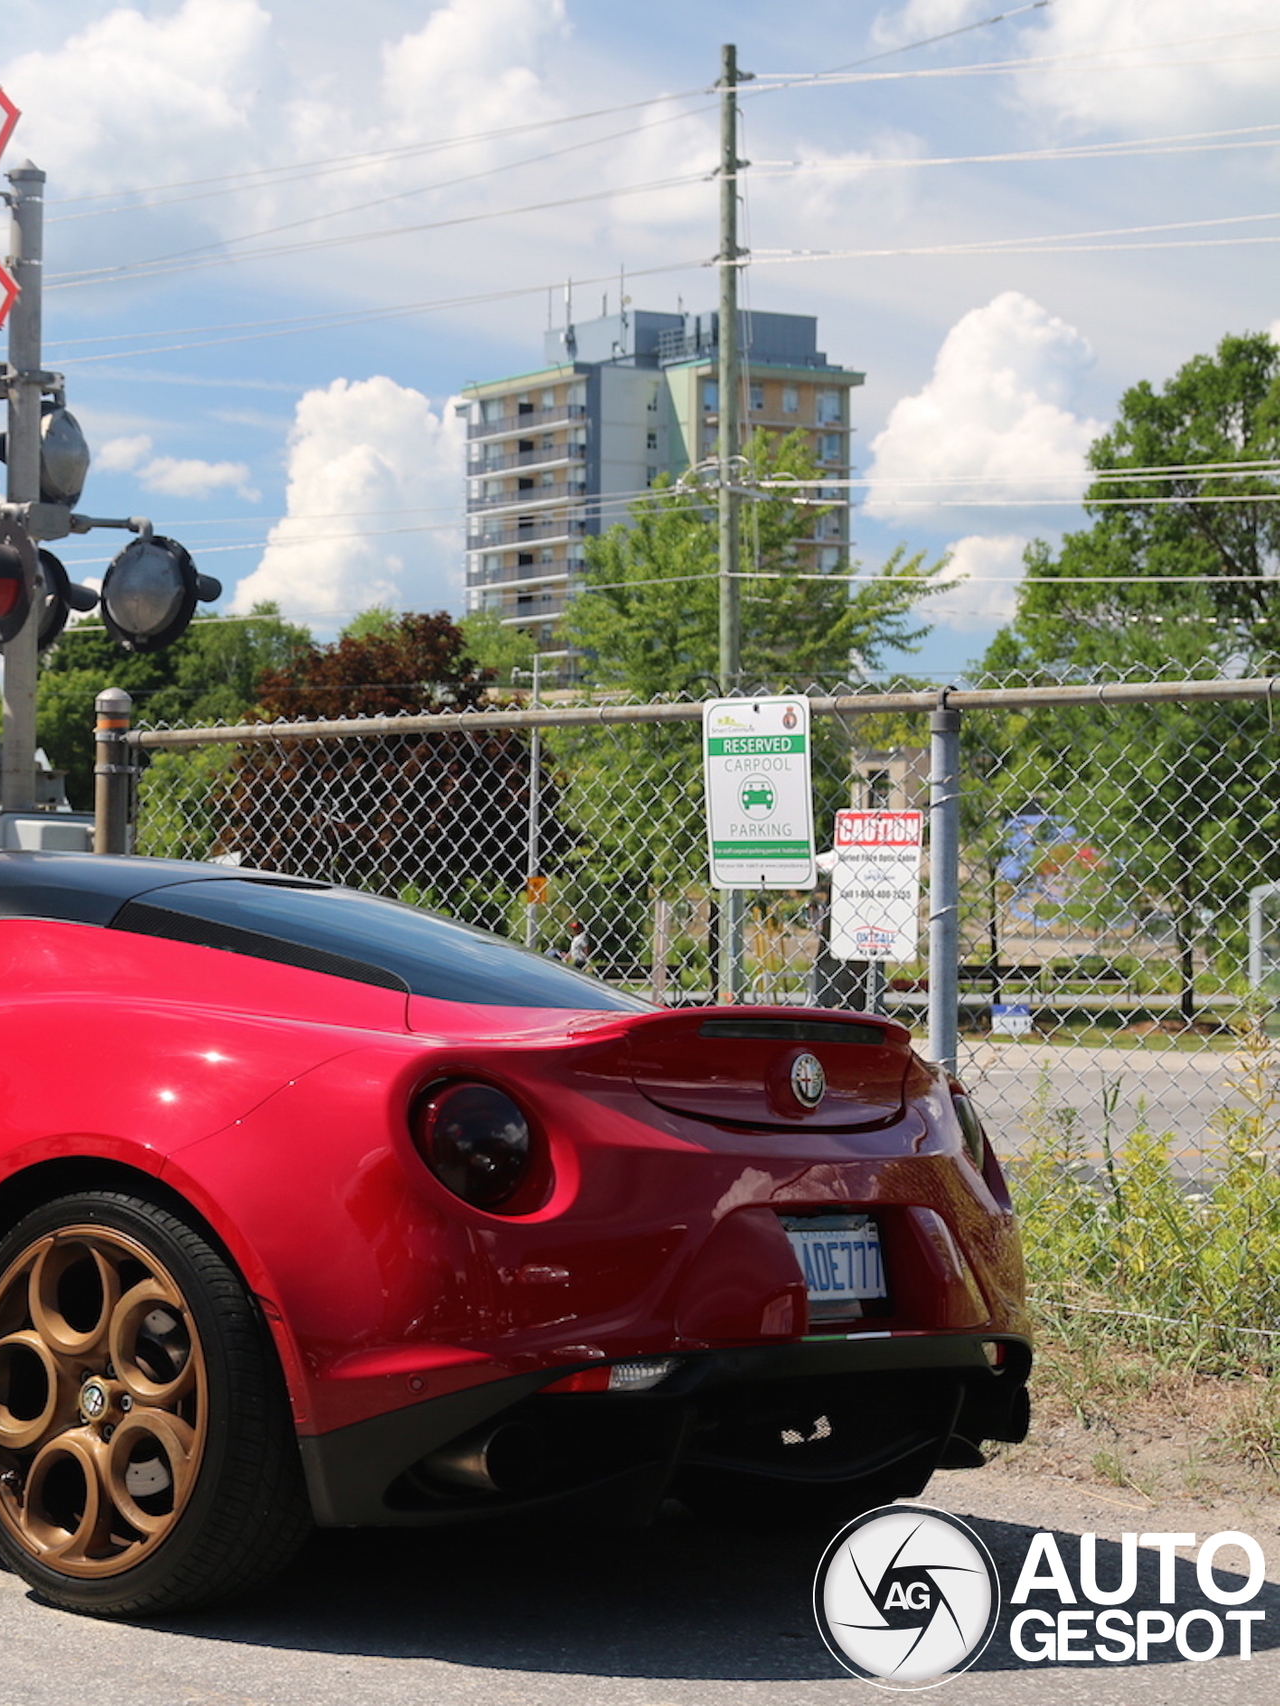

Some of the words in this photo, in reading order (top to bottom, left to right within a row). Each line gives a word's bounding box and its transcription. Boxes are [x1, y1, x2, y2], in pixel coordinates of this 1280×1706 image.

[723, 736, 792, 753] RESERVED
[724, 757, 793, 773] CARPOOL
[729, 823, 793, 837] PARKING
[838, 817, 919, 842] CAUTION
[791, 1241, 880, 1291] ADE777
